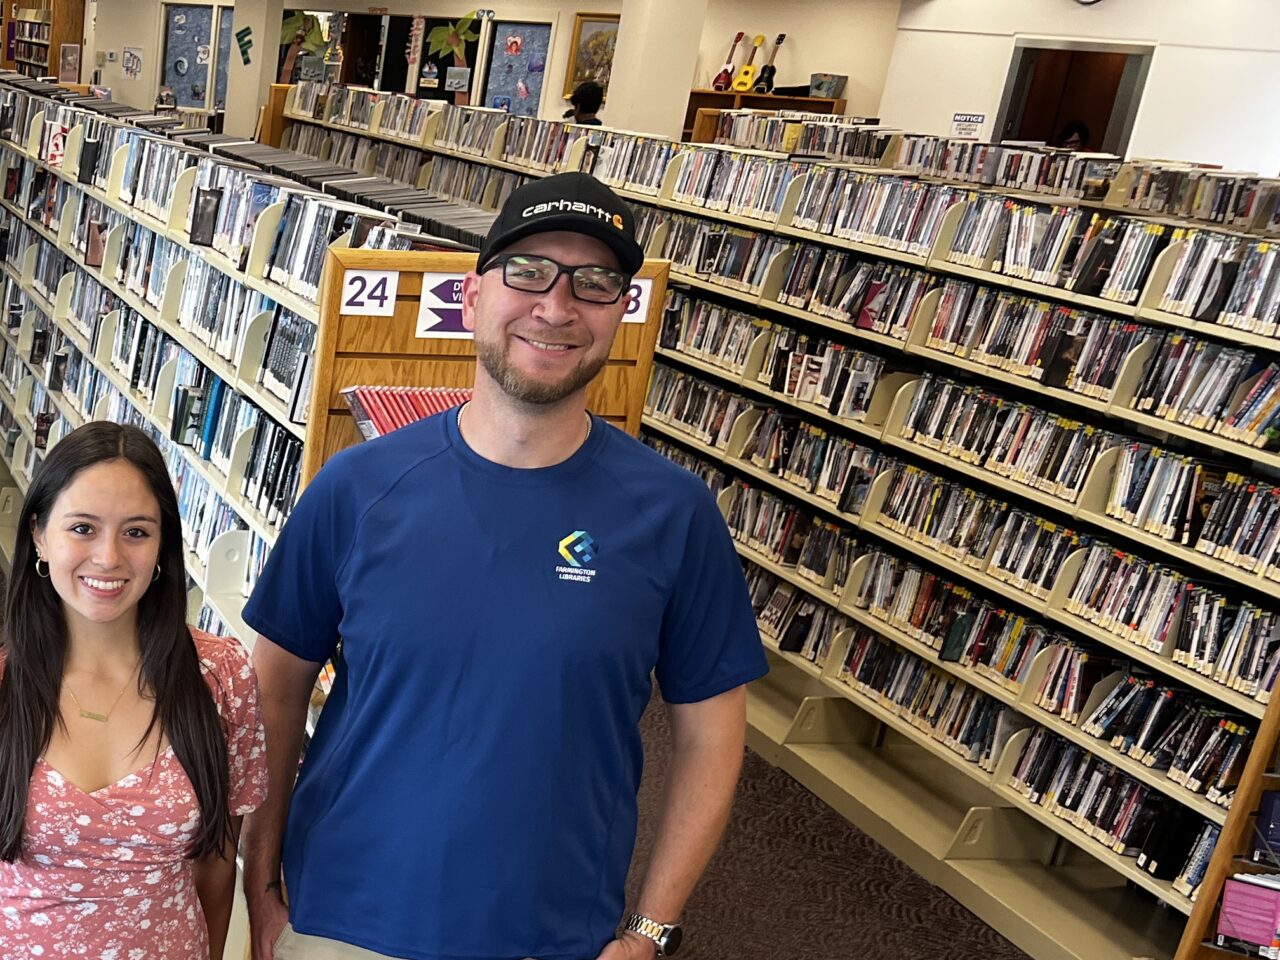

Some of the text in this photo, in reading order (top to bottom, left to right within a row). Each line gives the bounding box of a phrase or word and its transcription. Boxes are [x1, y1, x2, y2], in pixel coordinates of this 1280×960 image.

[235, 25, 253, 66] F
[954, 114, 984, 122] NOTICE
[522, 199, 612, 223] carhartt
[345, 275, 388, 308] 24
[555, 565, 596, 576] FARMINGTON
[559, 574, 591, 583] LIBRARIES
